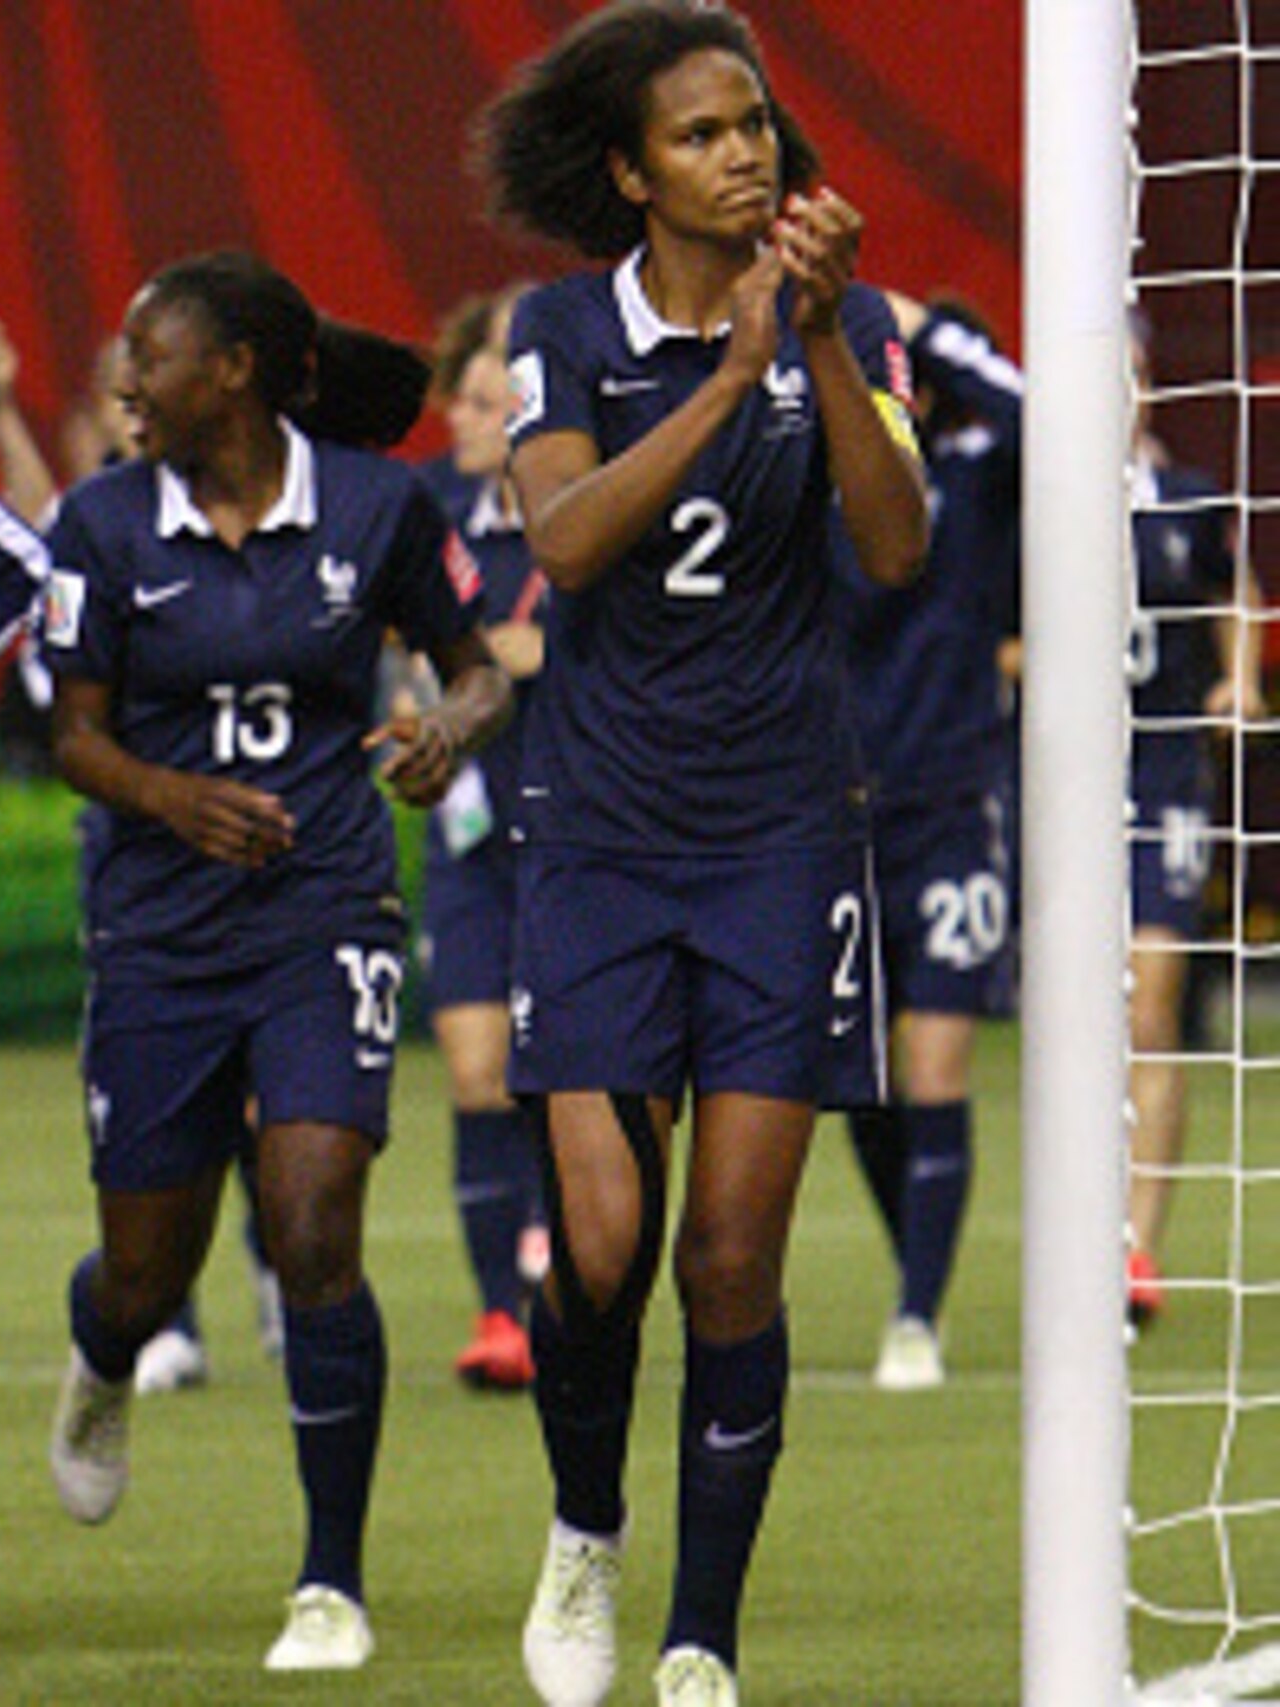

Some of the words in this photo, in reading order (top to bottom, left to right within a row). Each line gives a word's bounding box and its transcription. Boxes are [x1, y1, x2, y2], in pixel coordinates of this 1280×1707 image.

[664, 497, 728, 595] 2
[208, 684, 291, 763] 13
[830, 892, 862, 998] 2
[920, 872, 1007, 970] 20
